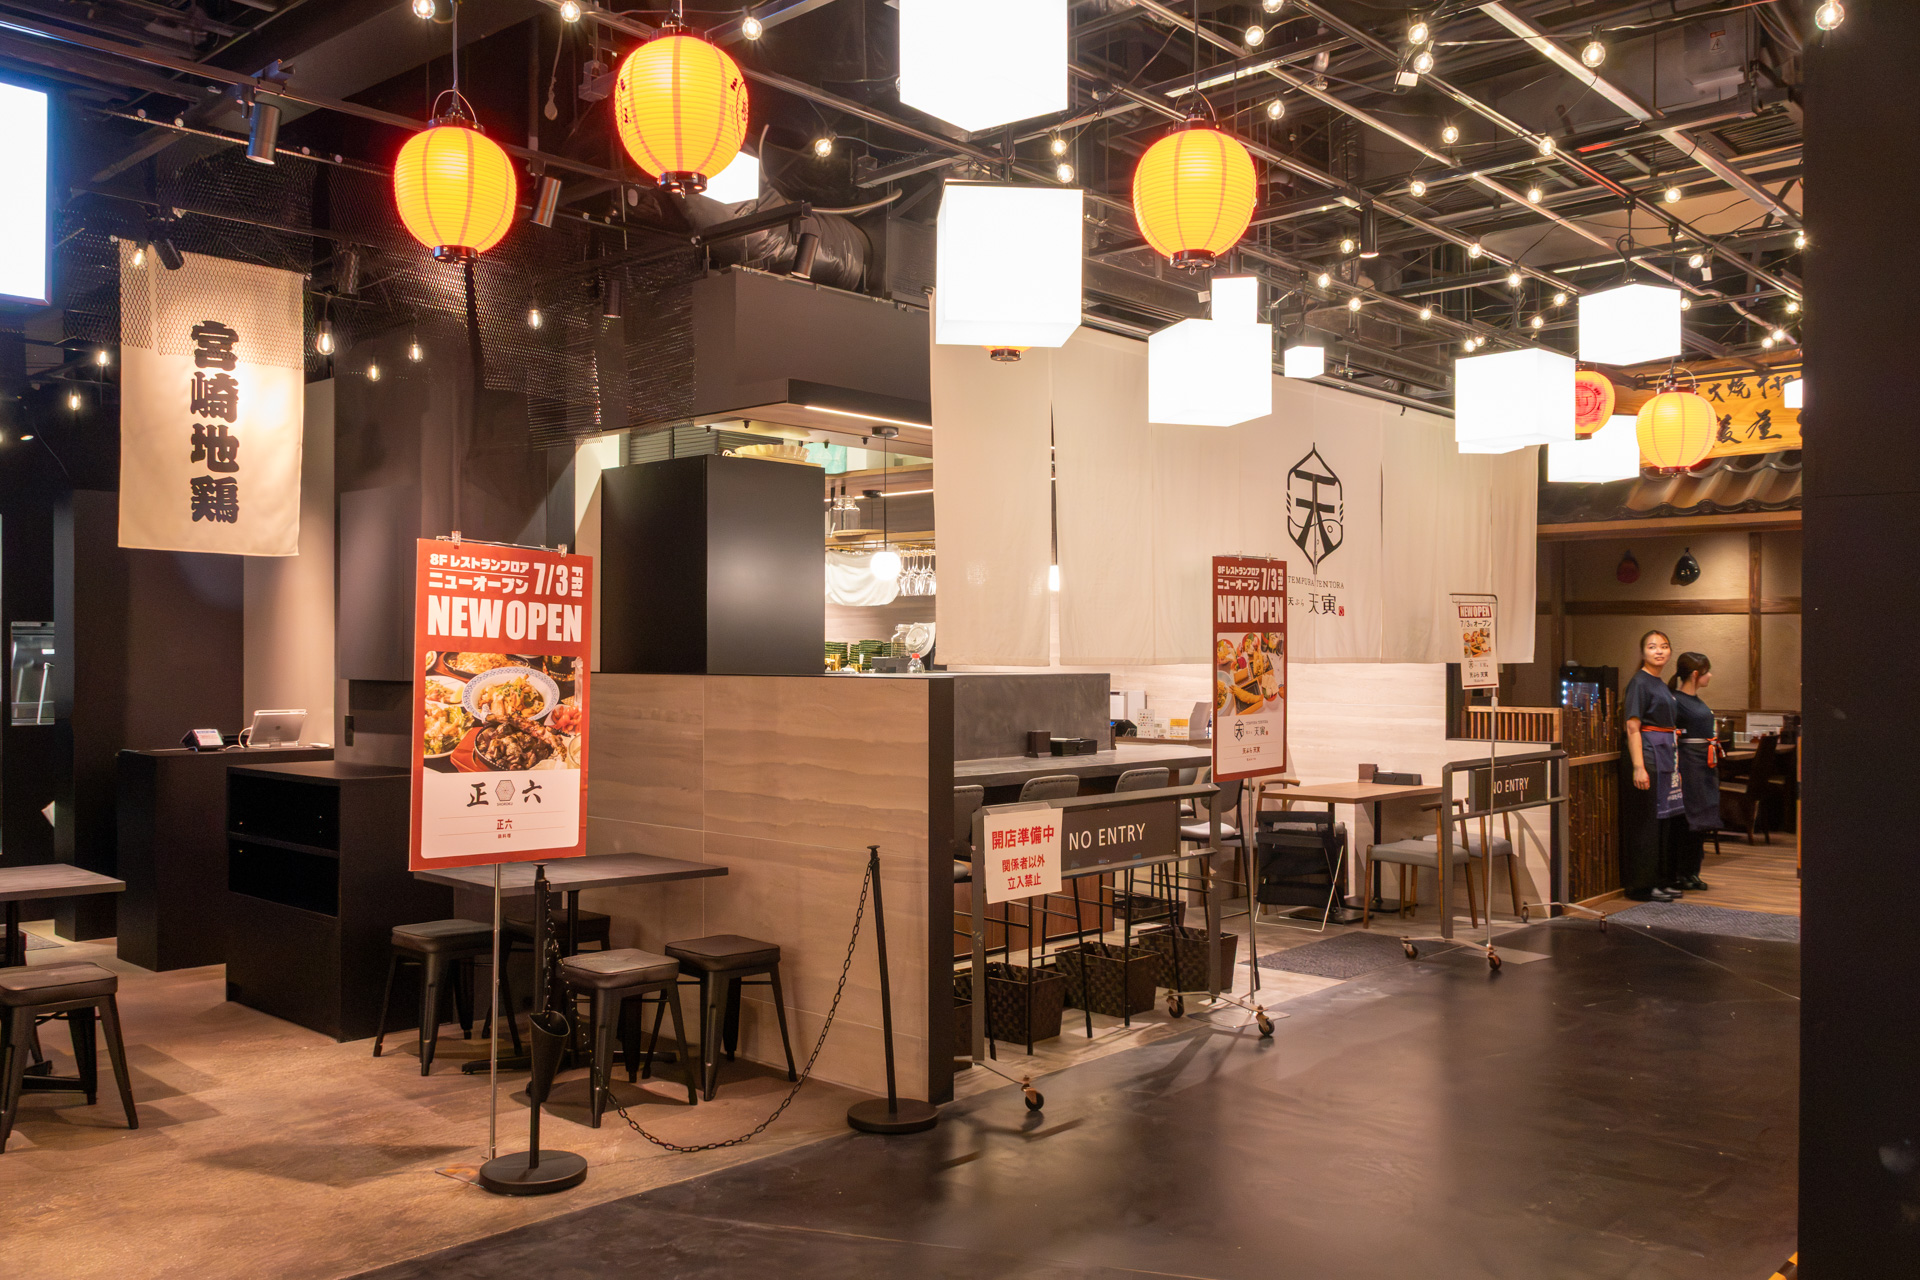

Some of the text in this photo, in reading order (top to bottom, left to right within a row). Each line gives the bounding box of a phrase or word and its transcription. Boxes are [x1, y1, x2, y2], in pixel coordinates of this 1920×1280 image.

[190, 320, 240, 524] 宮崎地鶏
[429, 553, 530, 574] 8F レストランフロア
[1217, 565, 1260, 577] 8F レストランフロア
[428, 571, 529, 595] ニューオープン
[533, 562, 569, 597] 7/3
[571, 566, 584, 598] FRI
[1217, 578, 1260, 592] ニューオープン
[1261, 567, 1277, 591] 7/3
[1287, 575, 1345, 590] TEMPURA TENTORA
[1217, 594, 1284, 624] NEW OPEN
[1308, 592, 1337, 616] 天寅
[1459, 605, 1491, 618] NEW OPEN
[427, 594, 583, 643] NEW OPEN
[1504, 777, 1530, 793] ENTRY
[496, 818, 513, 830] 正六
[991, 824, 1055, 851] 開店準備中
[1069, 822, 1146, 851] NO ENTRY
[1001, 853, 1046, 873] 関係者以外
[1007, 872, 1042, 891] 立入禁止
